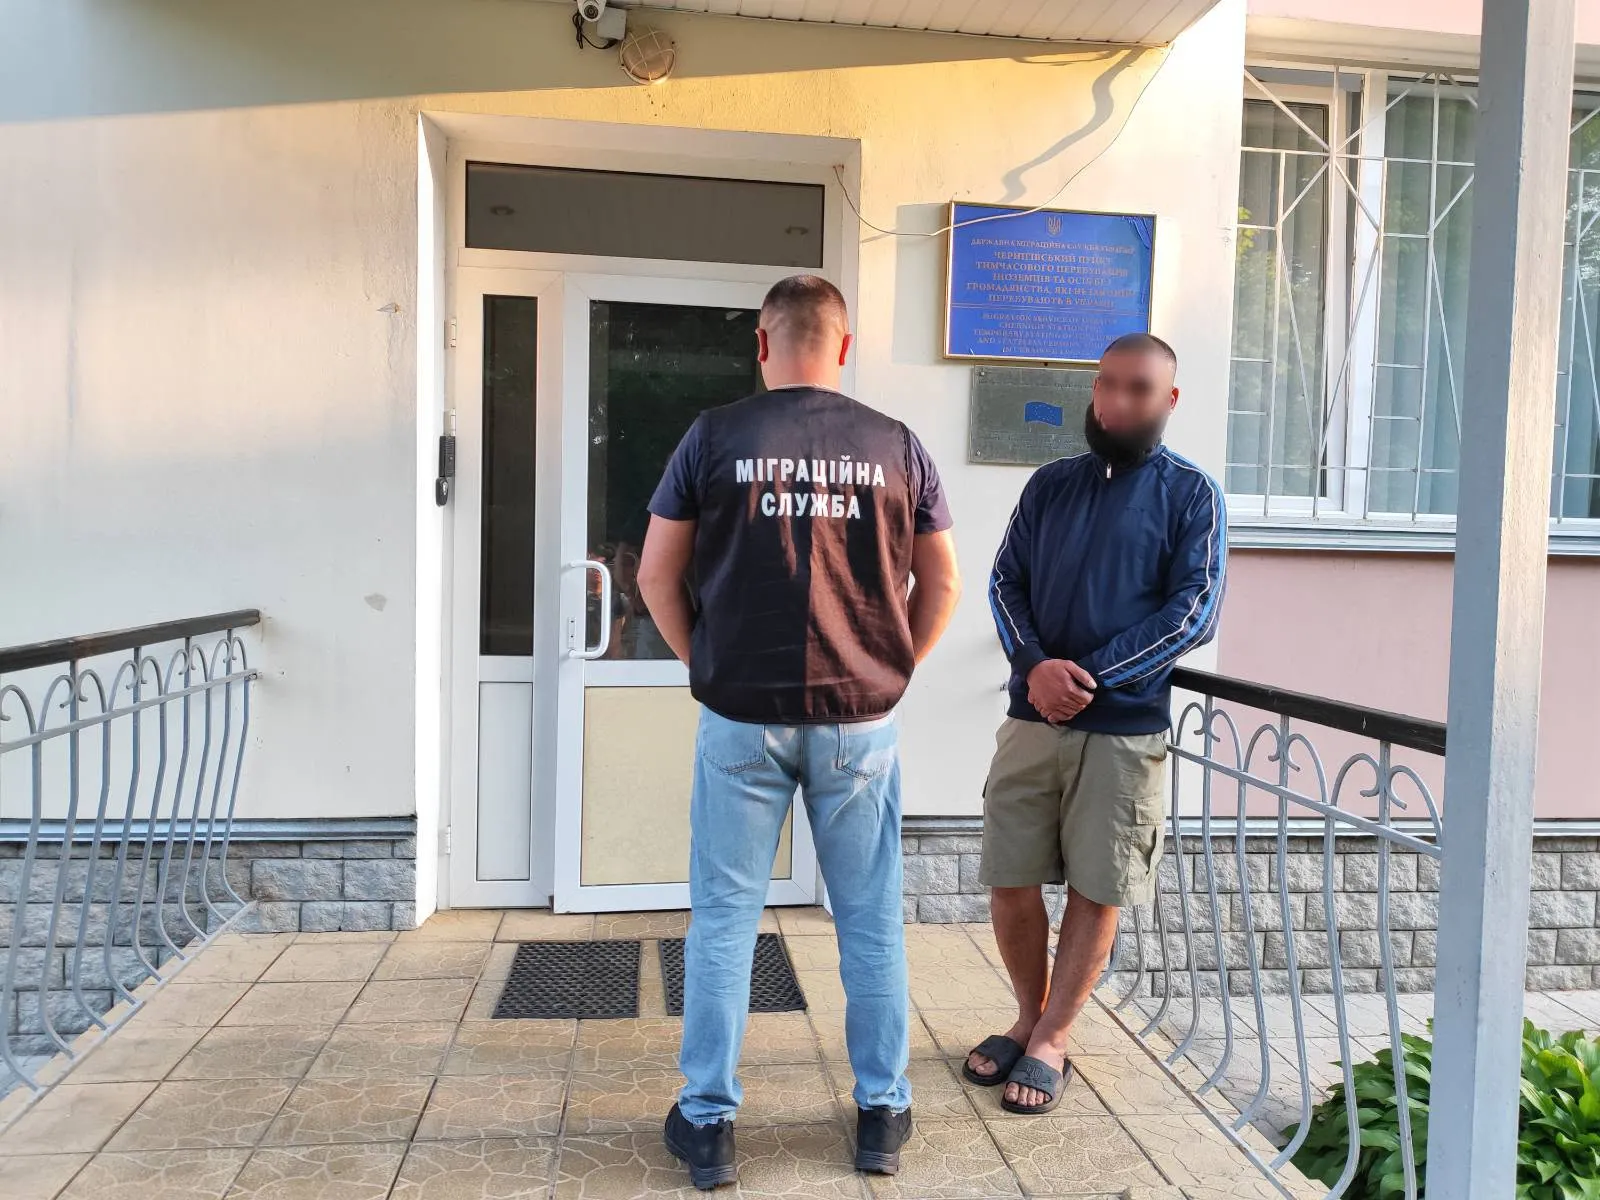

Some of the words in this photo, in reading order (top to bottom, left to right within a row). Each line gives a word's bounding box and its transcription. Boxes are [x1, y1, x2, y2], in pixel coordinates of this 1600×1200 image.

[976, 261, 1053, 273] ТИМЧАСОВОГО
[1053, 275, 1065, 283] ТА
[988, 294, 1063, 305] ПЕРЕБУВАЮТЬ
[1065, 297, 1073, 305] В
[735, 455, 886, 487] МІГРАЦІЙНА
[761, 492, 861, 519] СЛУЖБА
